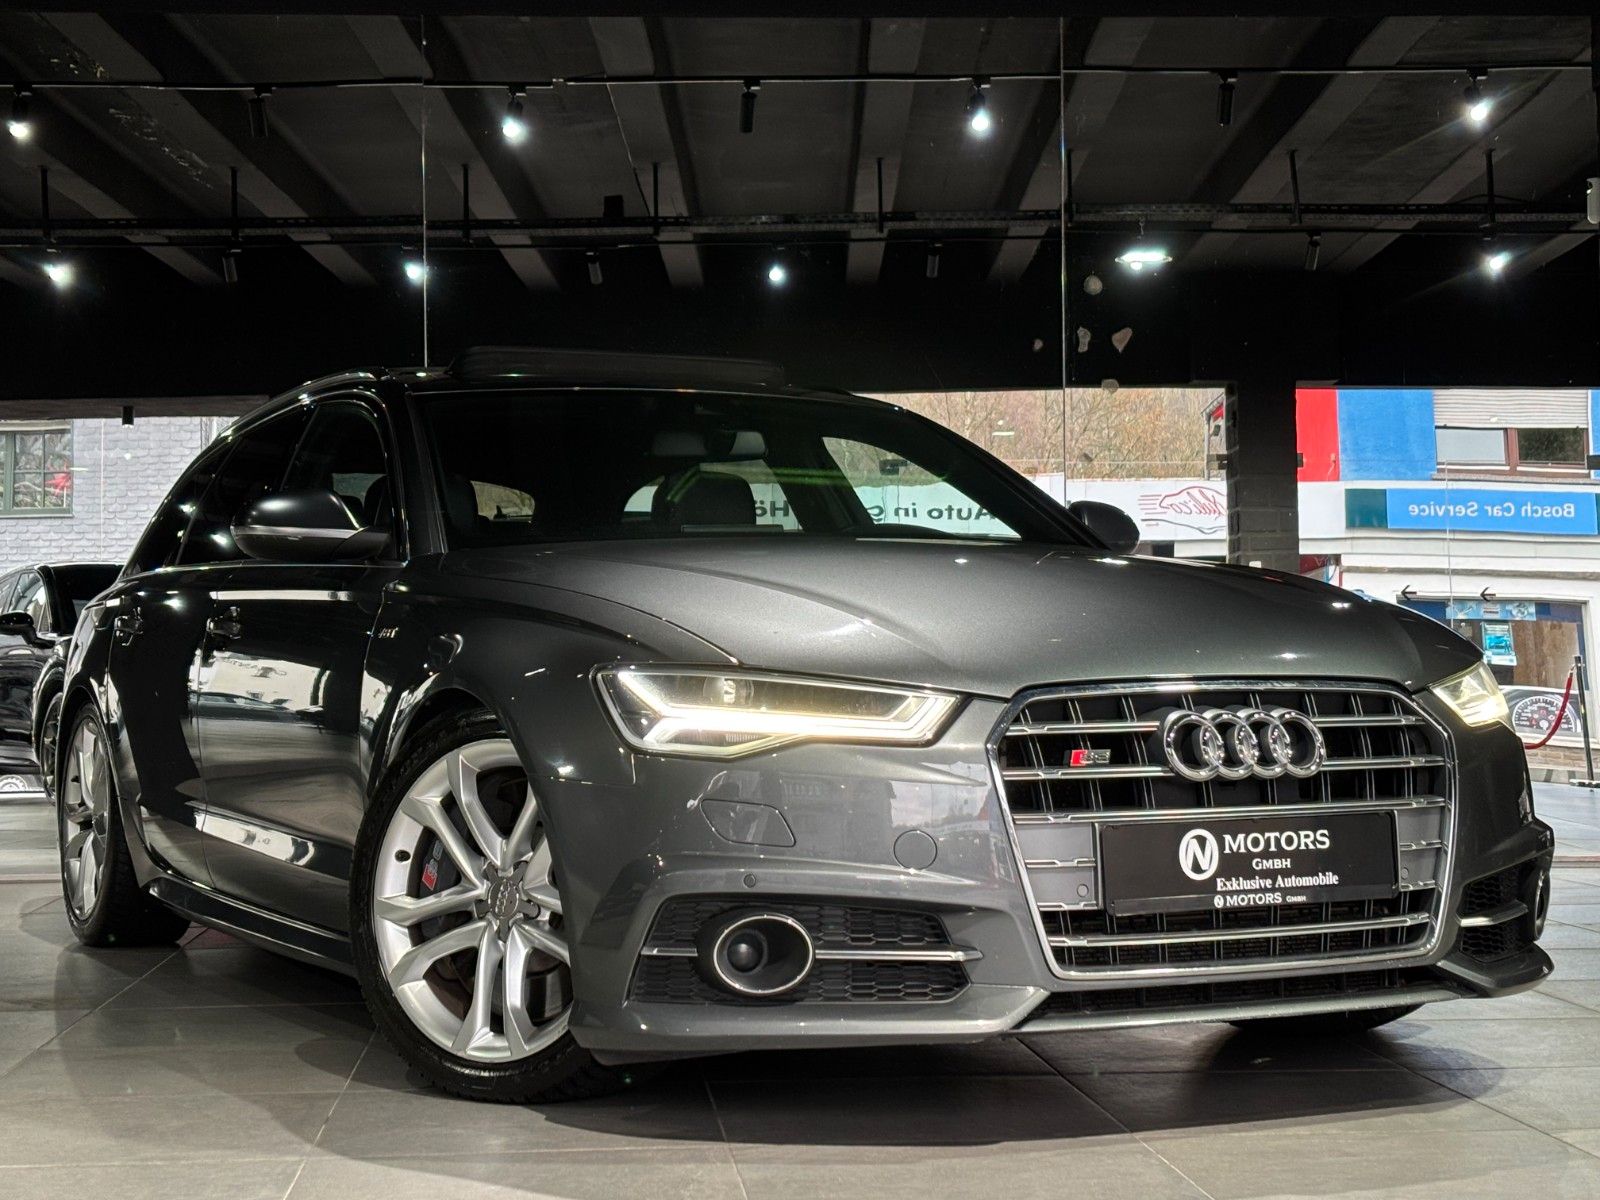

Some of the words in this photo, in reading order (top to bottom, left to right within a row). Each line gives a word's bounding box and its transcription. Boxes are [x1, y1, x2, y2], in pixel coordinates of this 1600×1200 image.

[1223, 829, 1330, 853] MOTORS
[1216, 876, 1273, 892] Exklusive
[1275, 873, 1338, 888] Automobile
[1226, 893, 1283, 906] MOTORS
